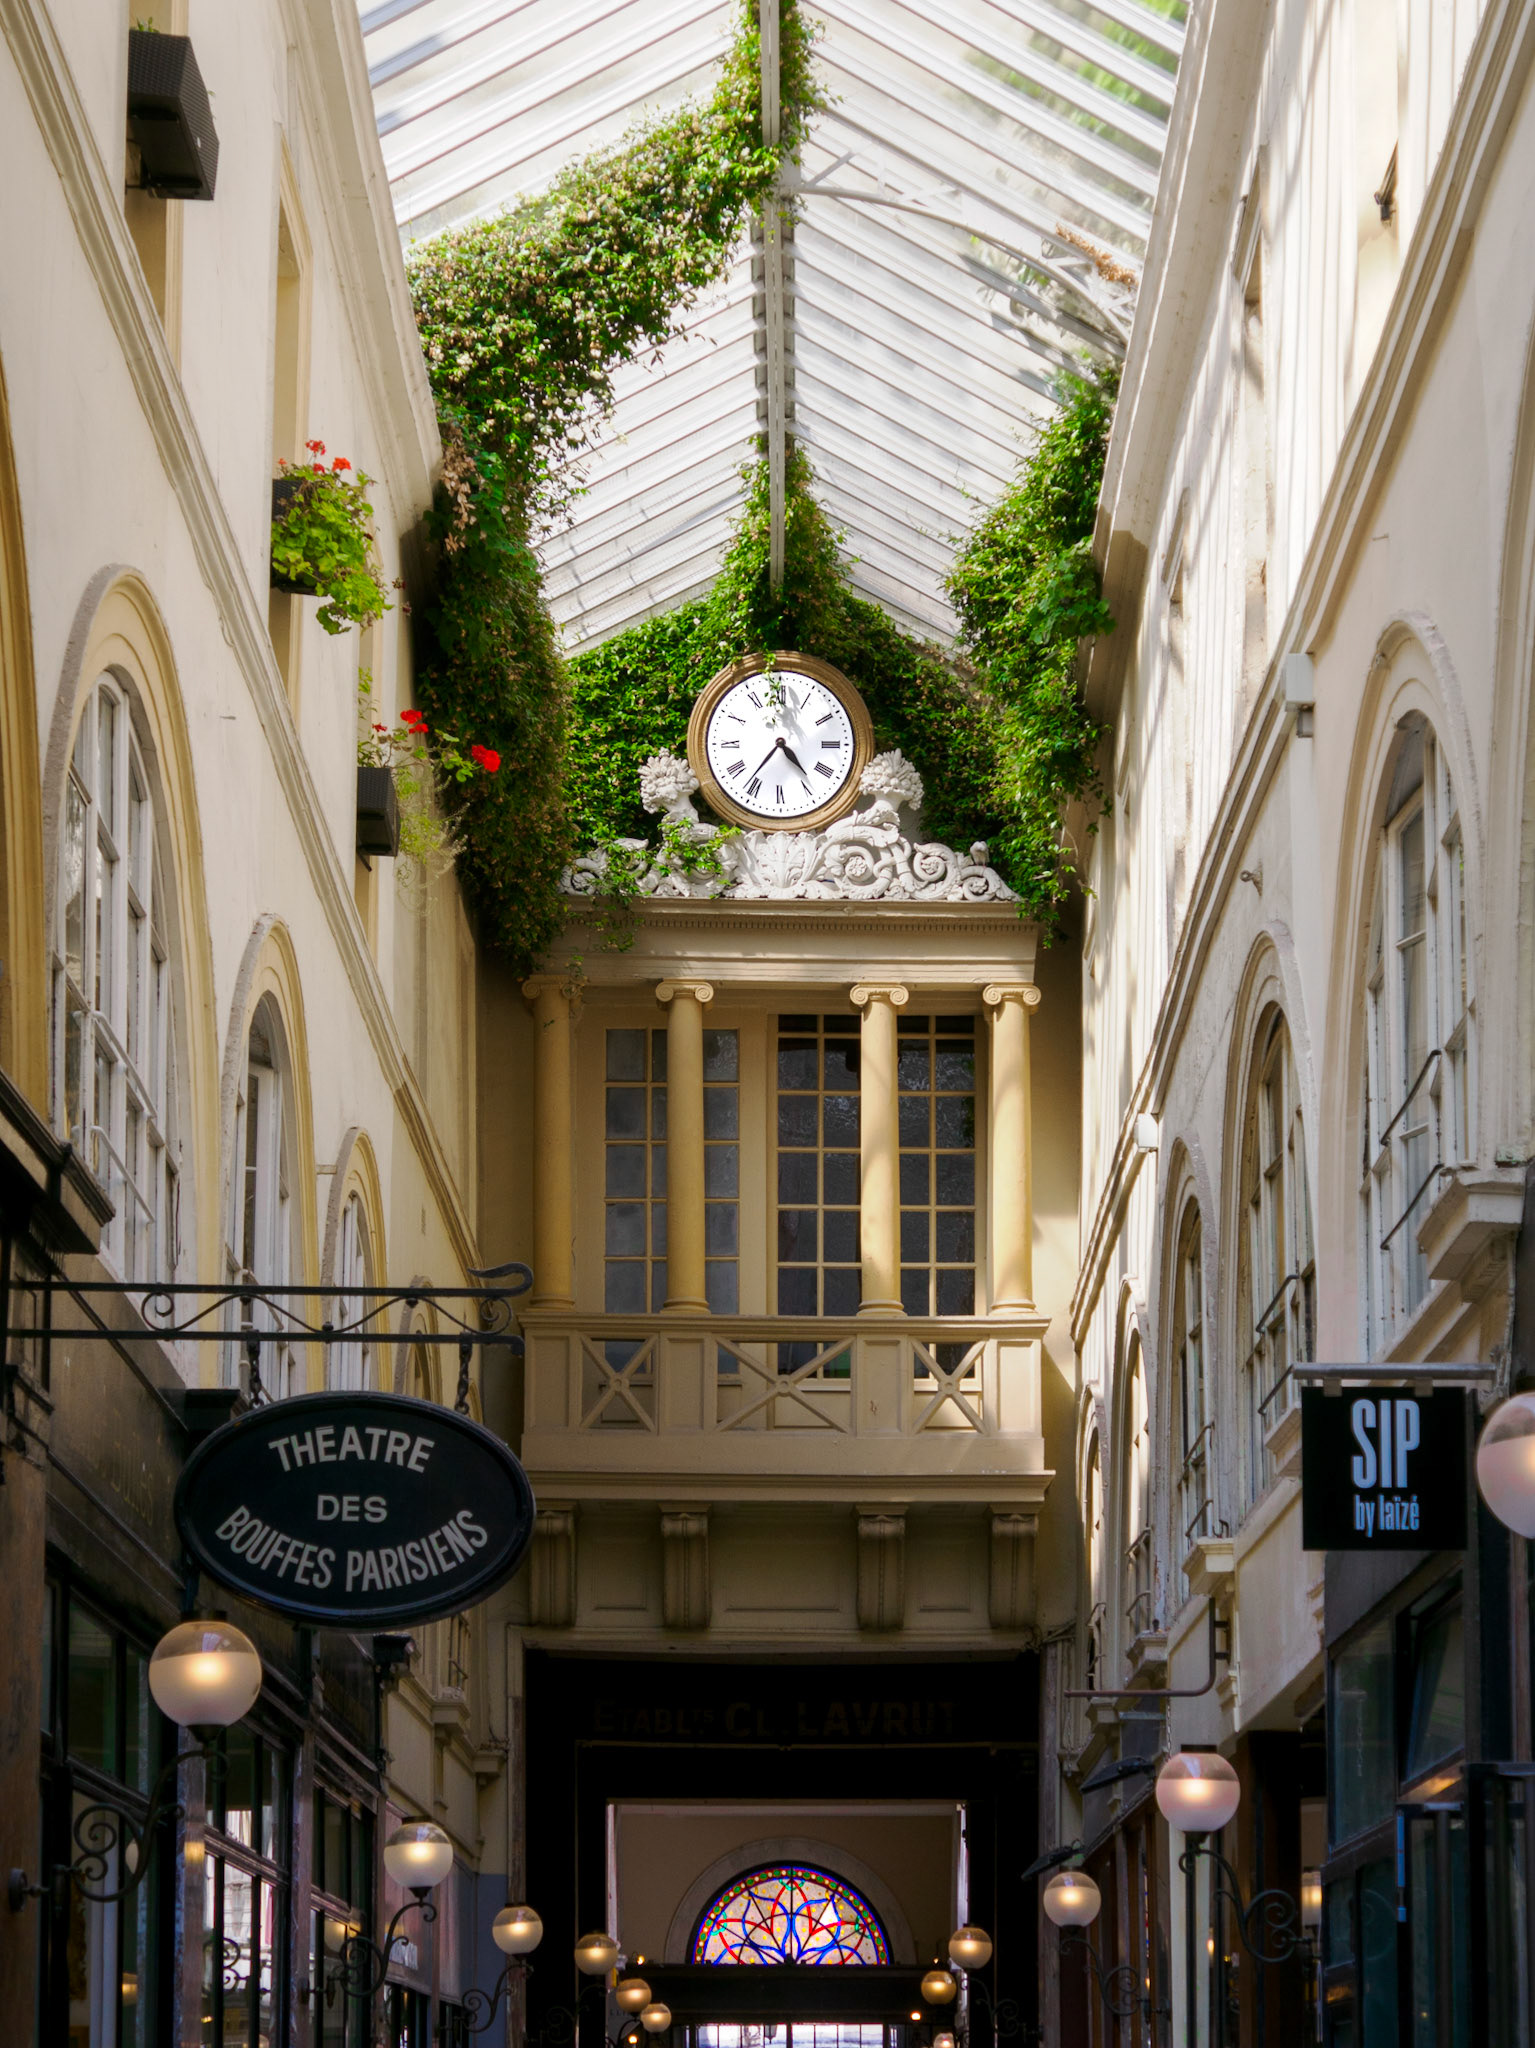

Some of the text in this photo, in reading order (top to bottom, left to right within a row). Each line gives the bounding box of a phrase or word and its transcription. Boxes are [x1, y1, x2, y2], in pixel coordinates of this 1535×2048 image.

[815, 712, 833, 726] II
[1351, 1399, 1420, 1488] SIP
[317, 1495, 388, 1523] DES
[1354, 1494, 1420, 1538] by laïzé
[215, 1505, 488, 1593] BOUFFES PARISIENS
[796, 1701, 958, 1737] LAVRUT
